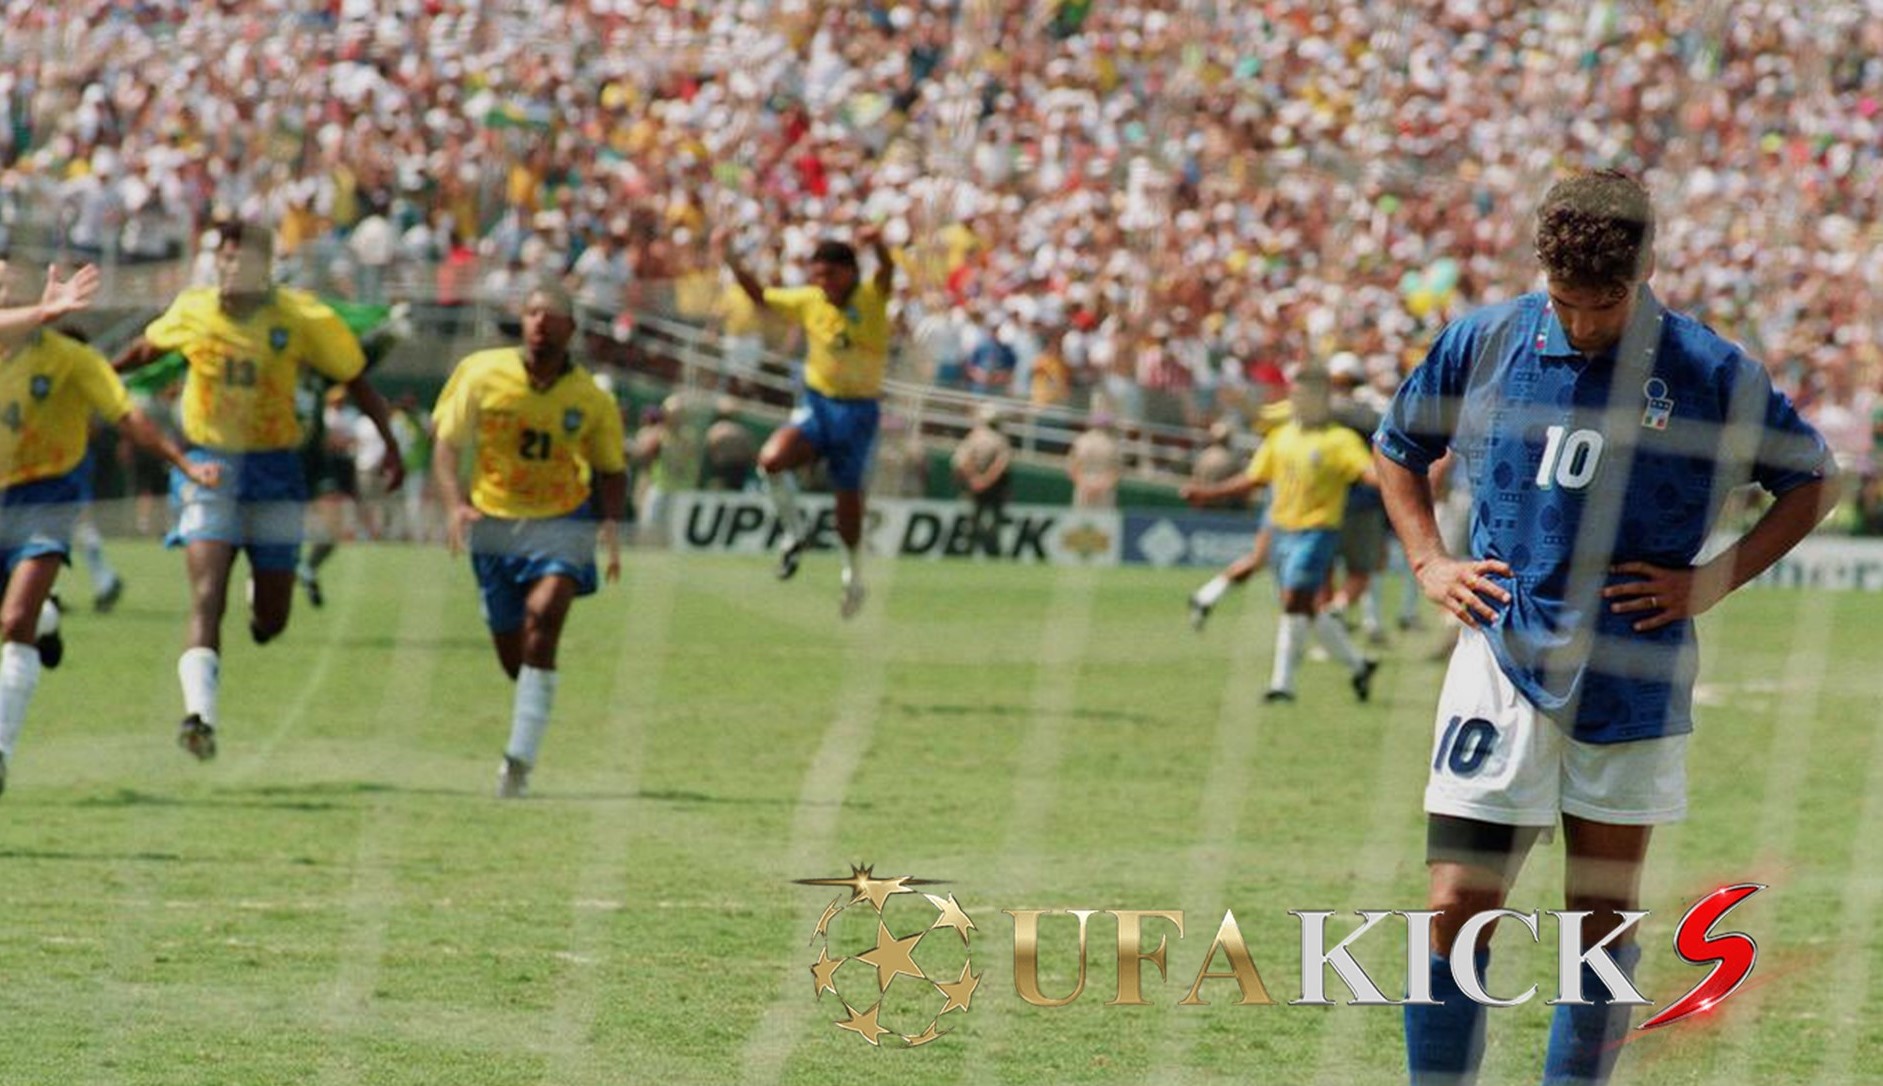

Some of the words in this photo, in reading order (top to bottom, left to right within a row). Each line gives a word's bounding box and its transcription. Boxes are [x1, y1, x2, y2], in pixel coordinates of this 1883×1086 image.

[519, 429, 551, 460] 21
[1536, 425, 1604, 490] 10
[1433, 715, 1499, 778] 10
